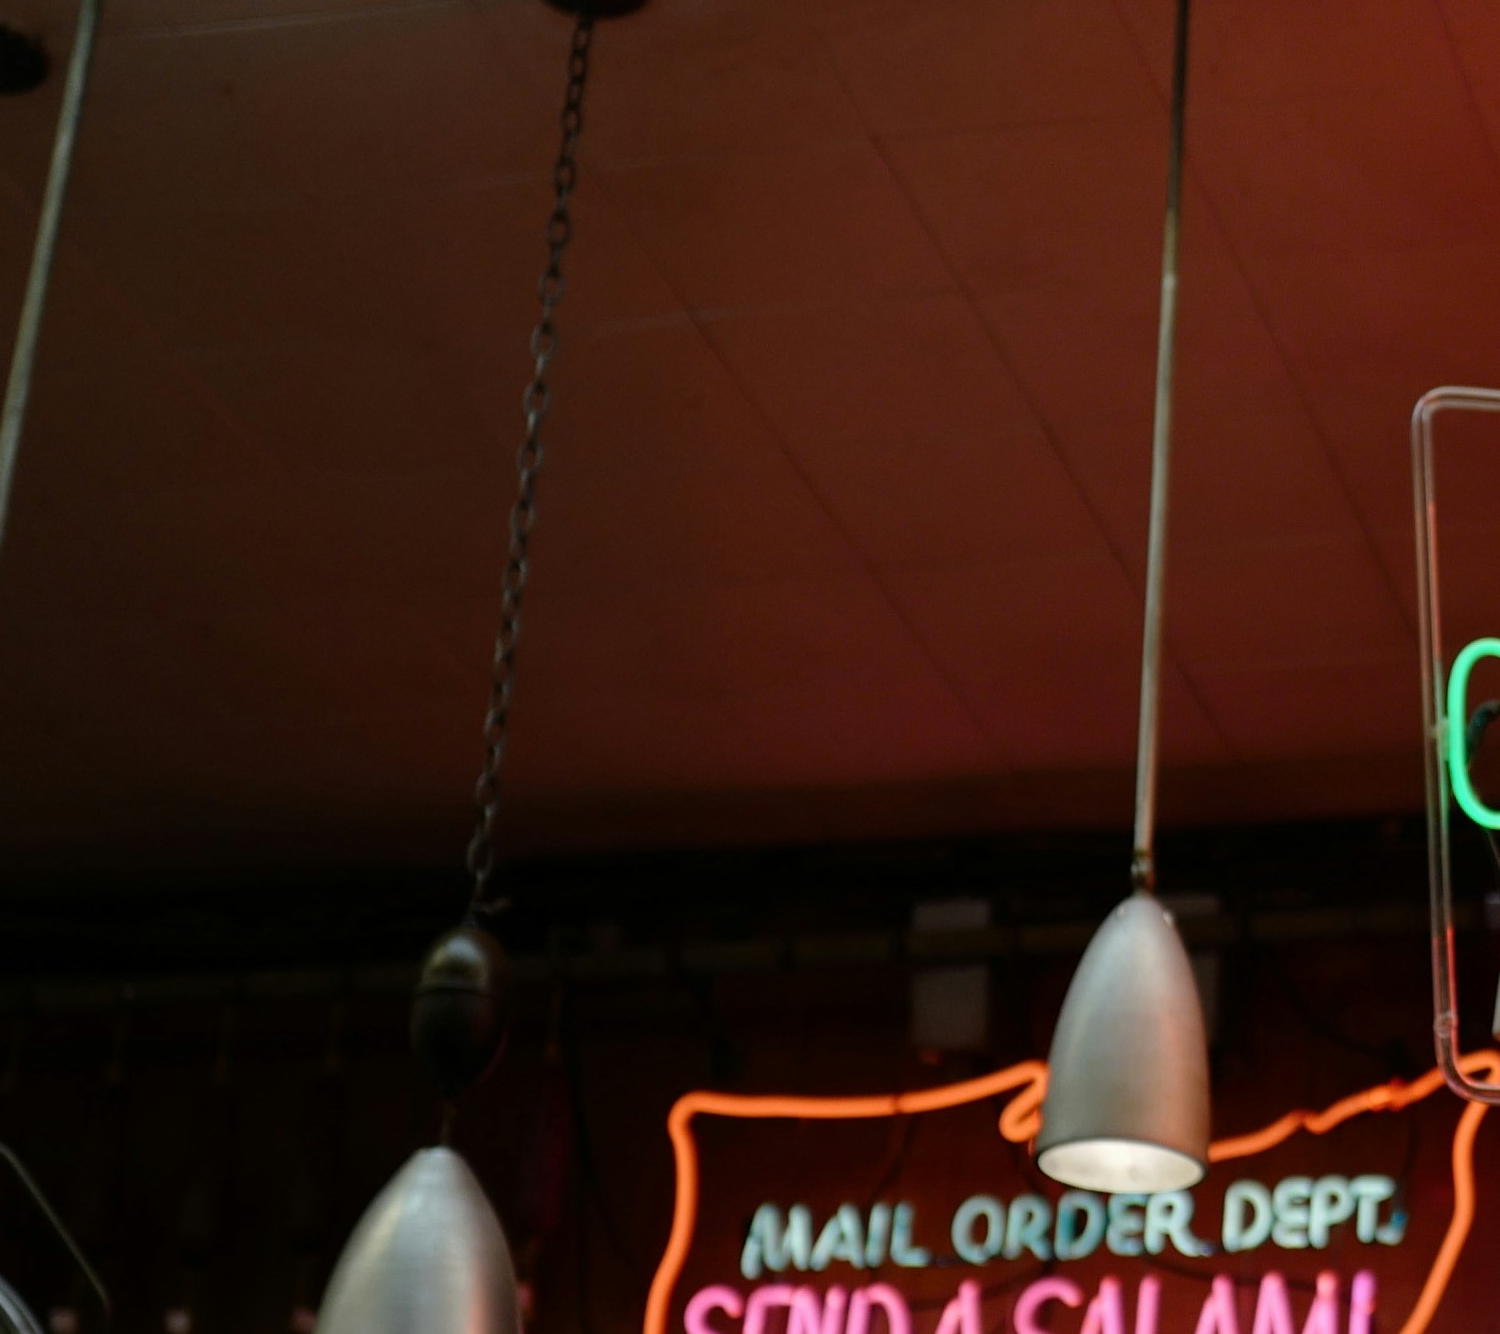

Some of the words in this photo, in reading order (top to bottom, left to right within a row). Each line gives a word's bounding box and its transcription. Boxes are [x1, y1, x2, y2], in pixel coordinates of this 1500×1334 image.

[740, 1202, 930, 1279] MAIL
[950, 1189, 1216, 1266] ORDER
[1221, 1172, 1405, 1252] DEPT.
